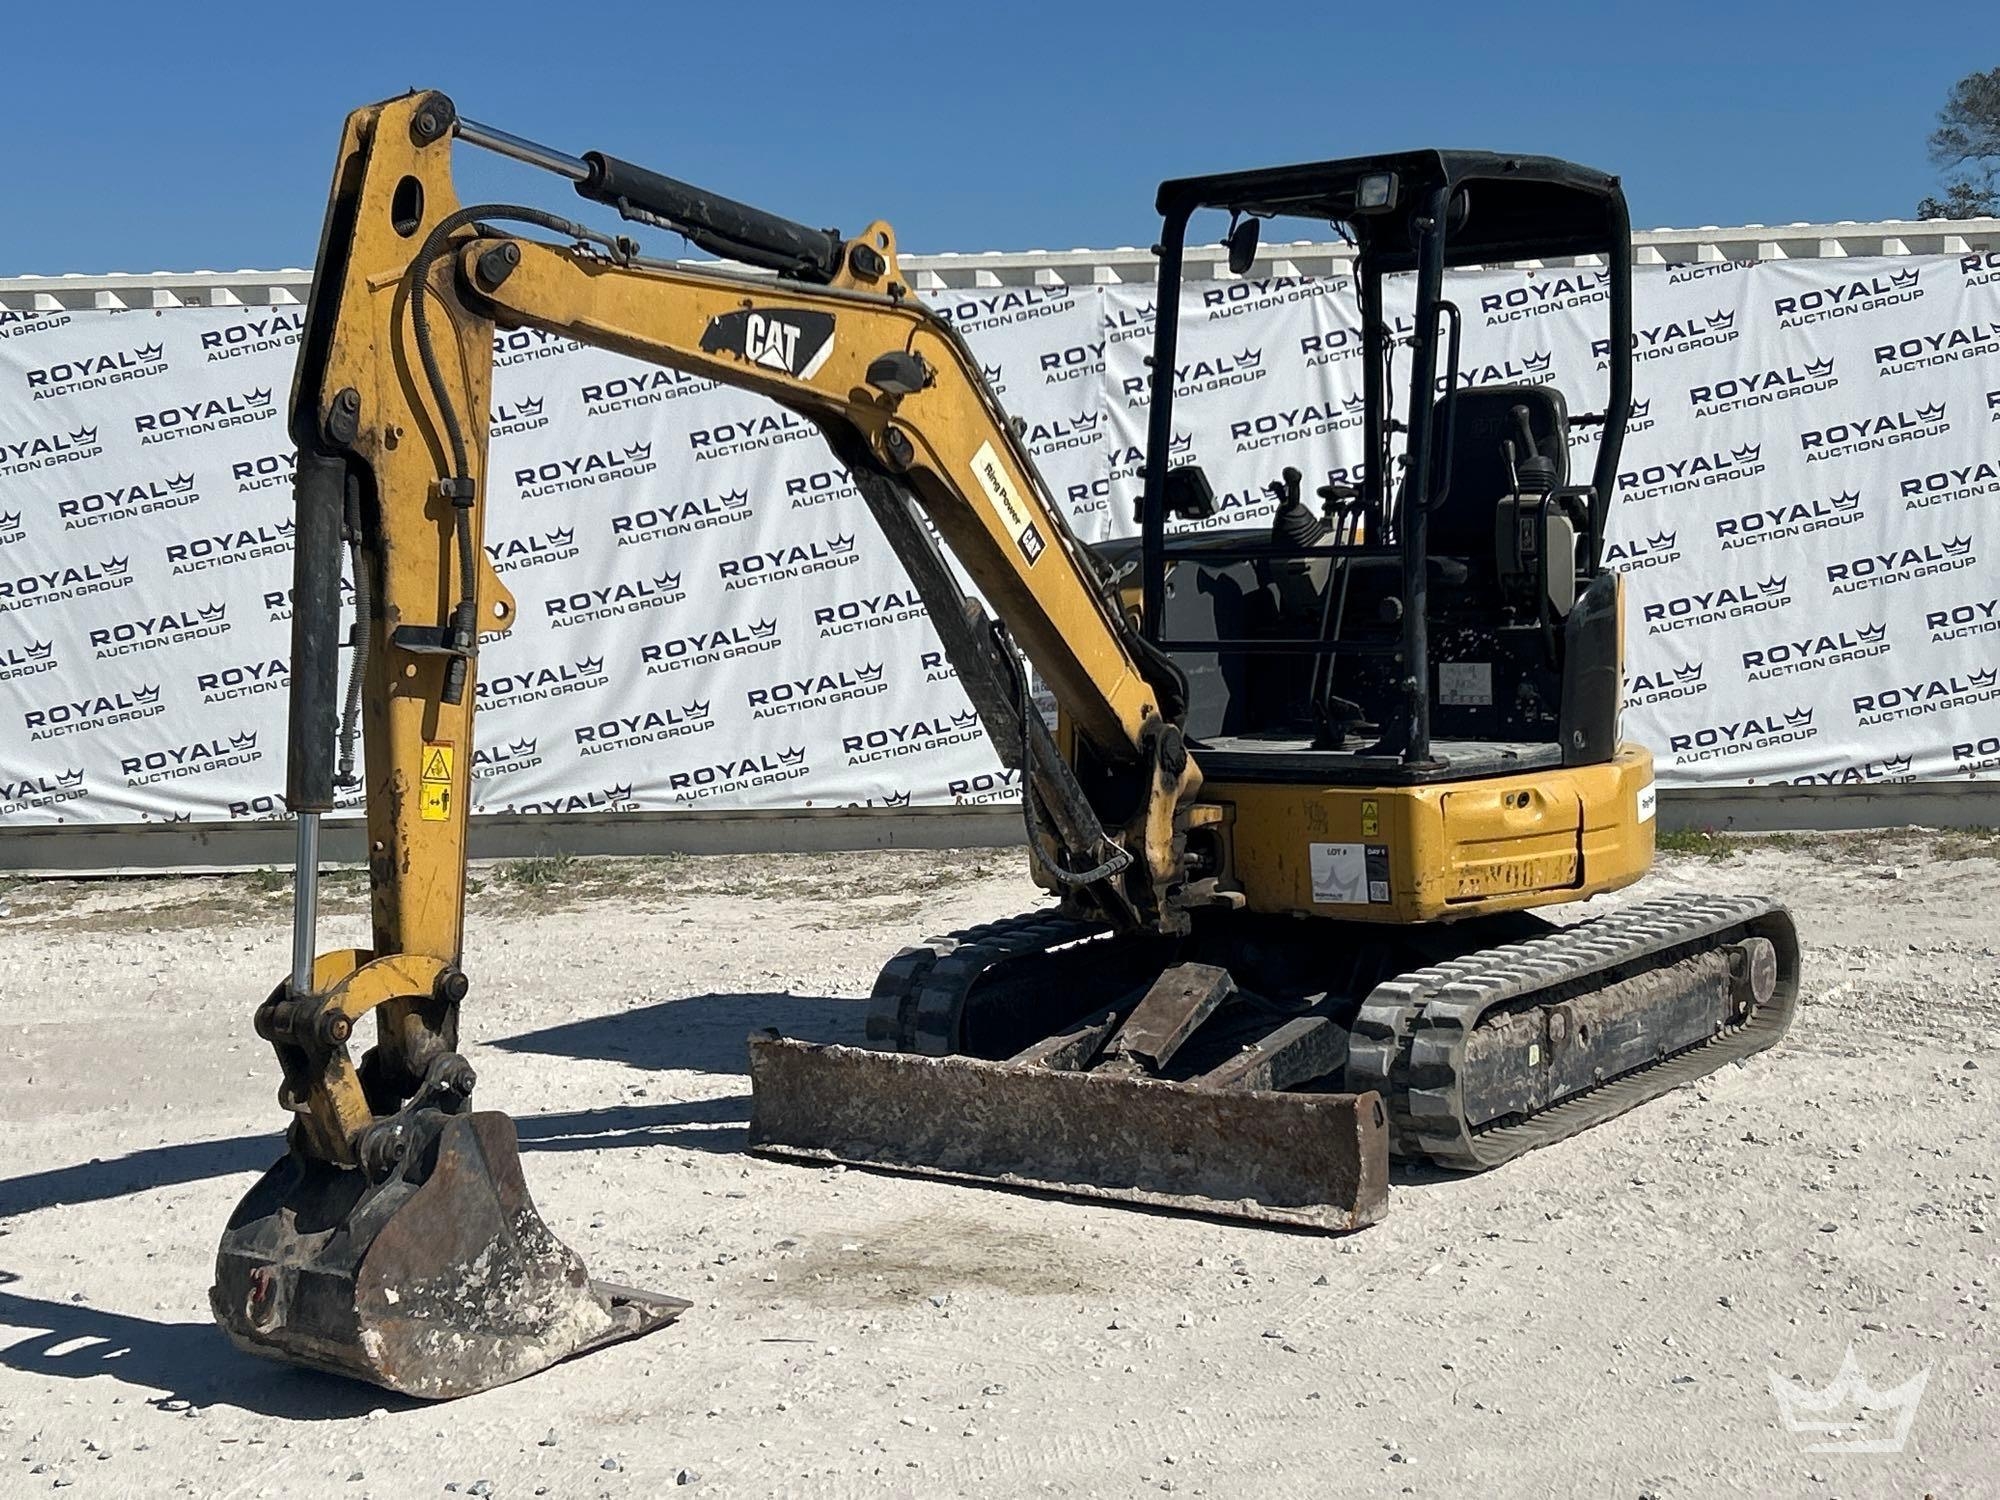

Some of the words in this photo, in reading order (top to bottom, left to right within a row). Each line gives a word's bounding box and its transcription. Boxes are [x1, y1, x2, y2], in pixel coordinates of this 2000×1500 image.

[1670, 260, 1746, 284] AUCTION
[1016, 301, 1076, 322] GROUP
[1209, 296, 1284, 320] AUCTION
[1288, 281, 1347, 301] GROUP
[1481, 274, 1595, 313] ROYAL
[1776, 278, 1890, 316] ROYAL
[1782, 304, 1858, 328] AUCTION
[1862, 290, 1922, 310] GROUP
[14, 315, 72, 336] GROUP
[201, 313, 304, 349] ROYAL
[1487, 302, 1563, 327] AUCTION
[207, 338, 281, 362] AUCTION
[492, 345, 565, 368] AUCTION
[746, 313, 800, 372] CAT
[1040, 342, 1107, 370] ROY
[1677, 331, 1740, 353] GROUP
[1875, 326, 1990, 364] ROYAL
[1881, 352, 1958, 376] AUCTION
[1962, 342, 2000, 359] GRO
[26, 352, 136, 388] ROYAL
[34, 376, 106, 400] AUCTION
[110, 364, 168, 384] GROUP
[582, 371, 691, 404] ROYAL
[1046, 363, 1107, 385] AUCTIO
[1206, 369, 1267, 391] GROUP
[1690, 368, 1804, 404] ROYAL
[136, 398, 244, 432] ROYAL
[588, 392, 662, 417] AUCTION
[1696, 394, 1772, 416] AUCTION
[1778, 378, 1838, 400] GROUP
[142, 422, 214, 446] AUCTION
[218, 408, 276, 428] GROUP
[491, 417, 549, 438] GROUP
[690, 413, 799, 449] ROYAL
[1231, 402, 1342, 439] ROYAL
[1237, 428, 1312, 452] AUCTION
[1315, 416, 1362, 435] GROU
[1802, 412, 1916, 450] ROYAL
[45, 446, 103, 468] GROUP
[695, 437, 769, 462] AUCTION
[773, 428, 820, 446] GROU
[1043, 432, 1104, 454] GROUP
[1808, 438, 1884, 462] AUCTION
[1888, 424, 1950, 444] GROUP
[232, 451, 298, 480] ROY
[516, 452, 624, 486] ROYAL
[522, 476, 594, 500] AUCTION
[598, 462, 656, 482] GROUP
[786, 470, 851, 496] ROY
[1618, 454, 1732, 490] ROYAL
[1624, 480, 1700, 502] AUCTION
[1704, 464, 1764, 486] GROUP
[1901, 462, 1997, 497] ROYA
[58, 482, 168, 518] ROYAL
[984, 462, 1001, 493] Ring
[999, 487, 1021, 525] Power
[1906, 485, 1984, 510] AUCTION
[64, 506, 138, 530] AUCTION
[142, 494, 200, 514] GROUP
[612, 498, 720, 534] ROYAL
[618, 522, 690, 546] AUCTION
[694, 510, 752, 530] GROUP
[1716, 500, 1830, 538] ROYAL
[166, 527, 276, 563] ROYAL
[484, 536, 547, 560] YAL
[1022, 528, 1041, 559] CAT
[1722, 526, 1798, 550] AUCTION
[1804, 512, 1864, 532] GROUP
[172, 551, 246, 576] AUCTION
[250, 540, 295, 560] GROU
[521, 548, 579, 568] GROUP
[718, 544, 828, 578] ROYAL
[724, 568, 798, 592] AUCTION
[802, 554, 860, 574] GROUP
[1620, 552, 1681, 573] GROUP
[1828, 546, 1942, 582] ROYAL
[1834, 572, 1910, 594] AUCTION
[1914, 556, 1976, 578] GROUP
[0, 588, 73, 612] AUCTION
[76, 576, 133, 596] GROUP
[546, 582, 654, 616] ROYAL
[552, 606, 624, 628] AUCTION
[628, 592, 684, 612] GROUP
[814, 590, 922, 626] ROYAL
[1644, 586, 1758, 622] ROYAL
[90, 612, 198, 648] ROYAL
[820, 614, 894, 639] AUCTION
[897, 607, 929, 622] GRO
[1650, 610, 1726, 636] AUCTION
[1730, 596, 1790, 618] GROUP
[1926, 600, 1998, 629] ROY
[1932, 621, 1999, 643] AUCTIO
[96, 636, 168, 660] AUCTION
[172, 622, 230, 642] GROUP
[642, 628, 748, 662] ROYAL
[648, 652, 720, 676] AUCTION
[724, 638, 782, 658] GROUP
[1742, 632, 1856, 670] ROYAL
[0, 660, 58, 681] GROUP
[197, 659, 290, 692] ROYA
[1748, 658, 1824, 682] AUCTION
[1830, 644, 1890, 664] GROUP
[204, 680, 278, 704] AUCTION
[474, 690, 546, 712] AUCTION
[550, 676, 609, 697] GROUP
[748, 672, 856, 708] ROYAL
[754, 696, 826, 720] AUCTION
[830, 684, 886, 702] GROUP
[1646, 683, 1707, 704] GROUP
[1854, 678, 1968, 714] ROYAL
[1860, 702, 1934, 728] AUCTION
[1940, 688, 2000, 710] GROUP
[24, 694, 134, 728] ROYAL
[32, 718, 104, 742] AUCTION
[108, 704, 166, 724] GROUP
[576, 710, 682, 744] ROYAL
[580, 732, 654, 756] AUCTION
[658, 720, 714, 740] GROUP
[844, 718, 950, 754] ROYAL
[850, 742, 920, 766] AUCTION
[926, 730, 982, 750] GROUP
[1670, 716, 1782, 752] ROYAL
[1676, 742, 1752, 764] AUCTION
[1756, 728, 1816, 748] GROUP
[122, 740, 230, 776] ROYAL
[128, 764, 200, 788] AUCTION
[204, 752, 260, 772] GROUP
[484, 757, 541, 778] GROUP
[670, 756, 778, 790] ROYAL
[0, 778, 57, 801] YAL
[31, 788, 88, 808] GROUP
[676, 780, 748, 802] AUCTION
[752, 766, 808, 786] GROUP
[949, 769, 1017, 796] ROY
